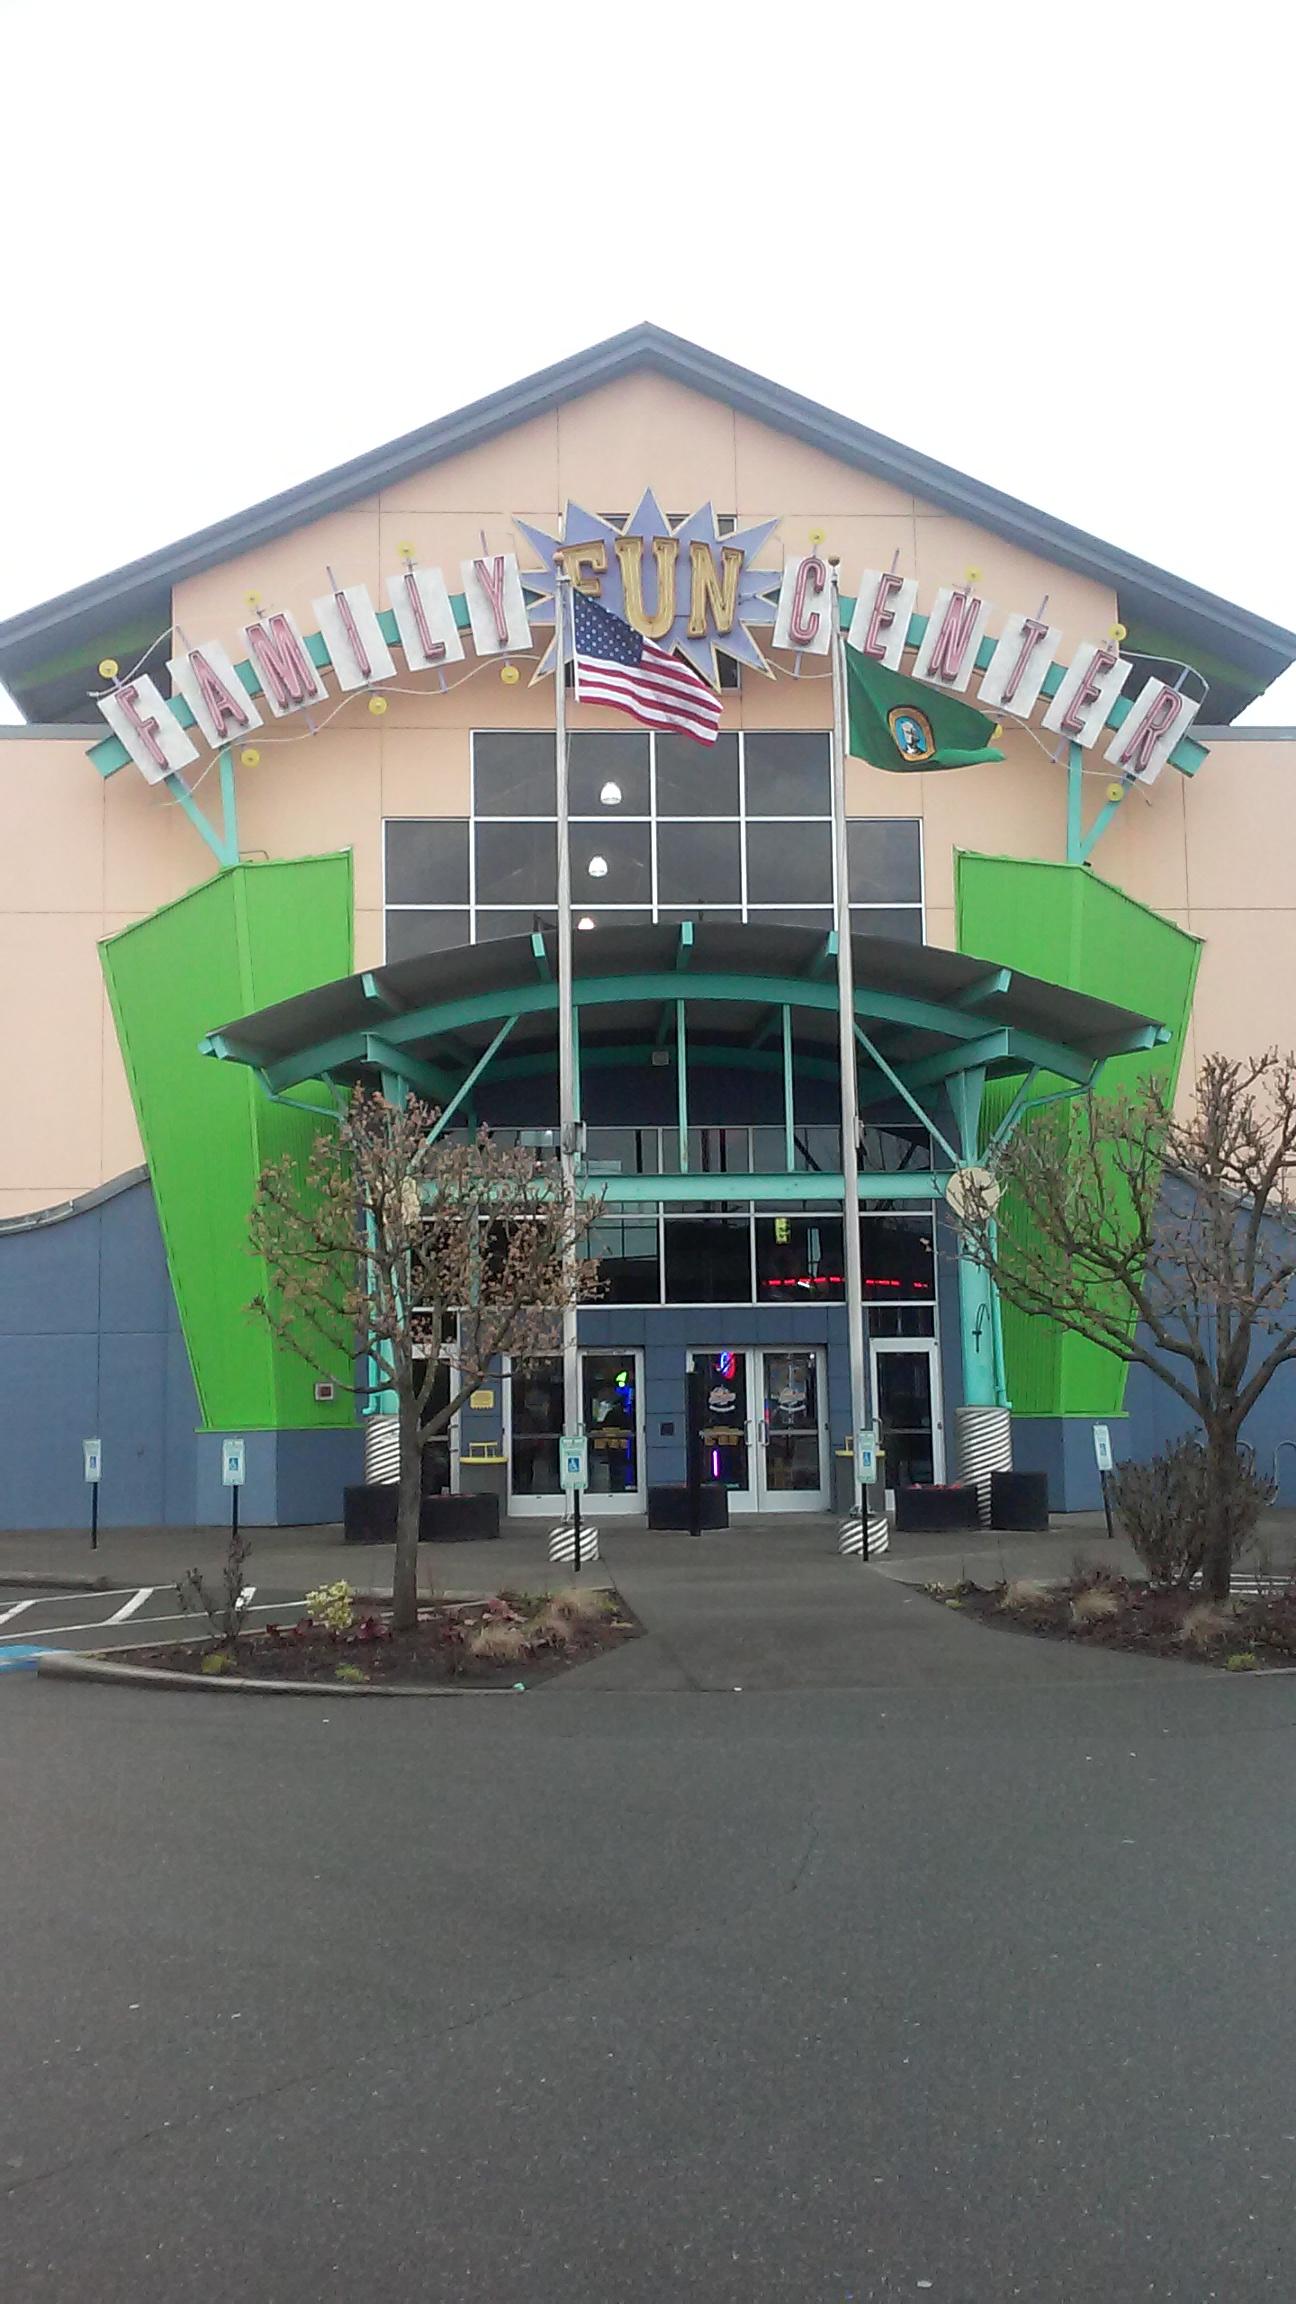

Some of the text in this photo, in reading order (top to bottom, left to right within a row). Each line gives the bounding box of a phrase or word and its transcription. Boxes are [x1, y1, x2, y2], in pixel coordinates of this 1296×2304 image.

[114, 535, 1184, 773] FAMILY FUN CENTER
